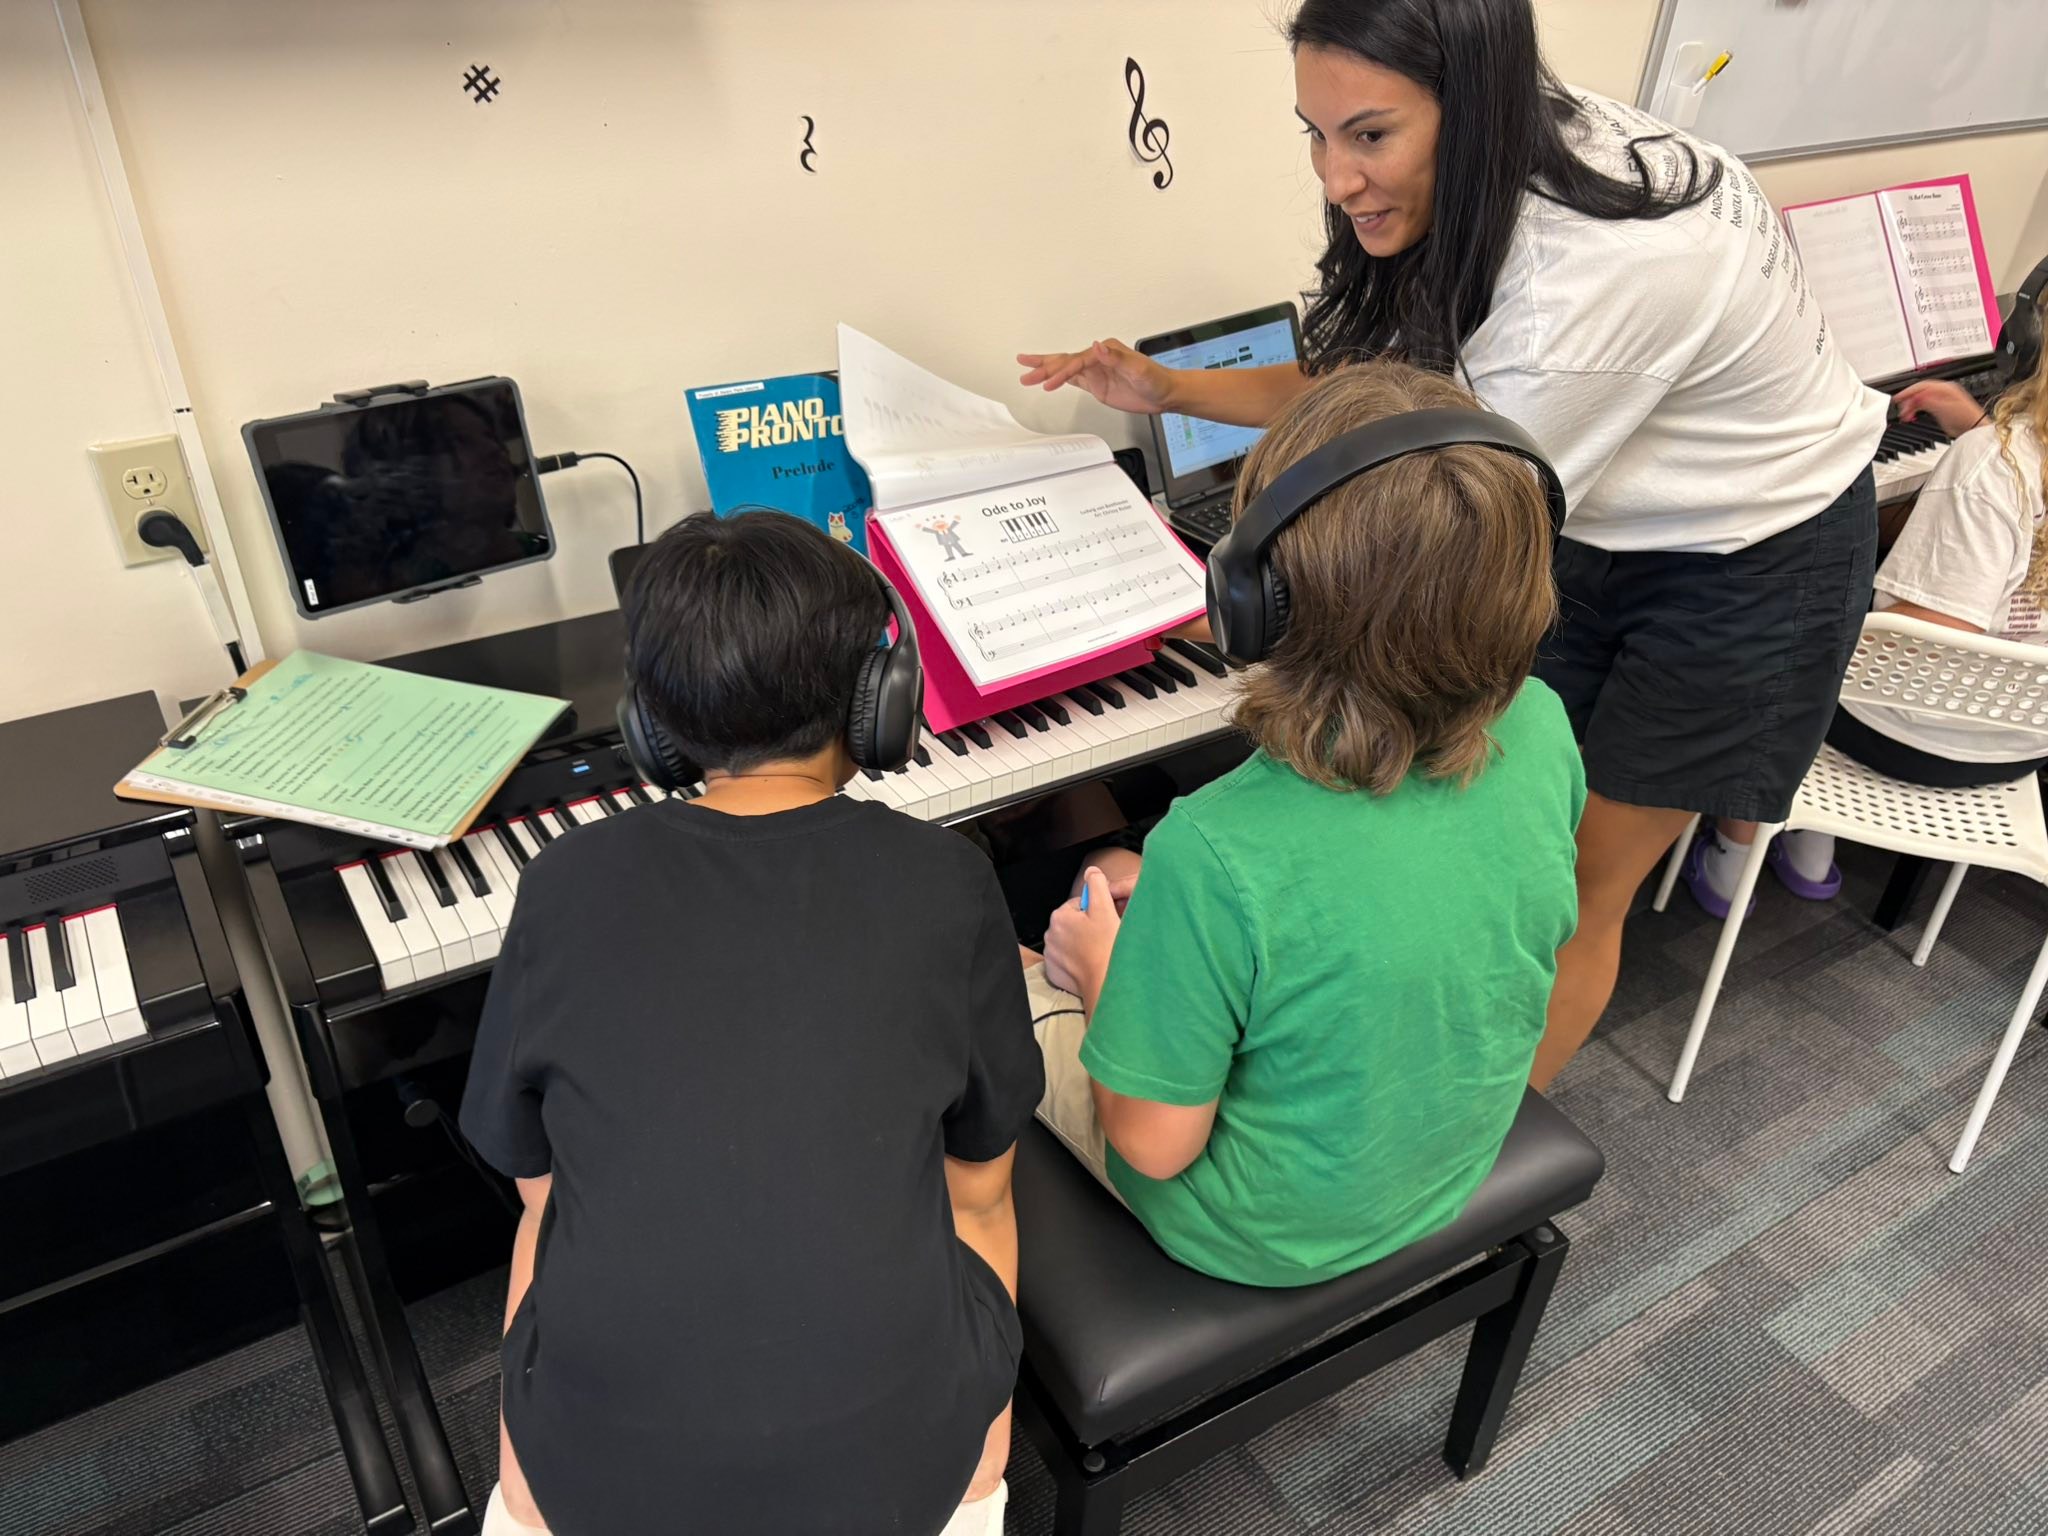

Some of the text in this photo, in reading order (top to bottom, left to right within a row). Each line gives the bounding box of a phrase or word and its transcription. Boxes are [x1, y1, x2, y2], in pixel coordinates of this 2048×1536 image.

[1729, 193, 1742, 229] ANNIKA
[716, 396, 825, 432] PIANO
[717, 413, 845, 453] PRONTO
[771, 459, 836, 480] Prelude
[981, 495, 1047, 517] Ode to Joy
